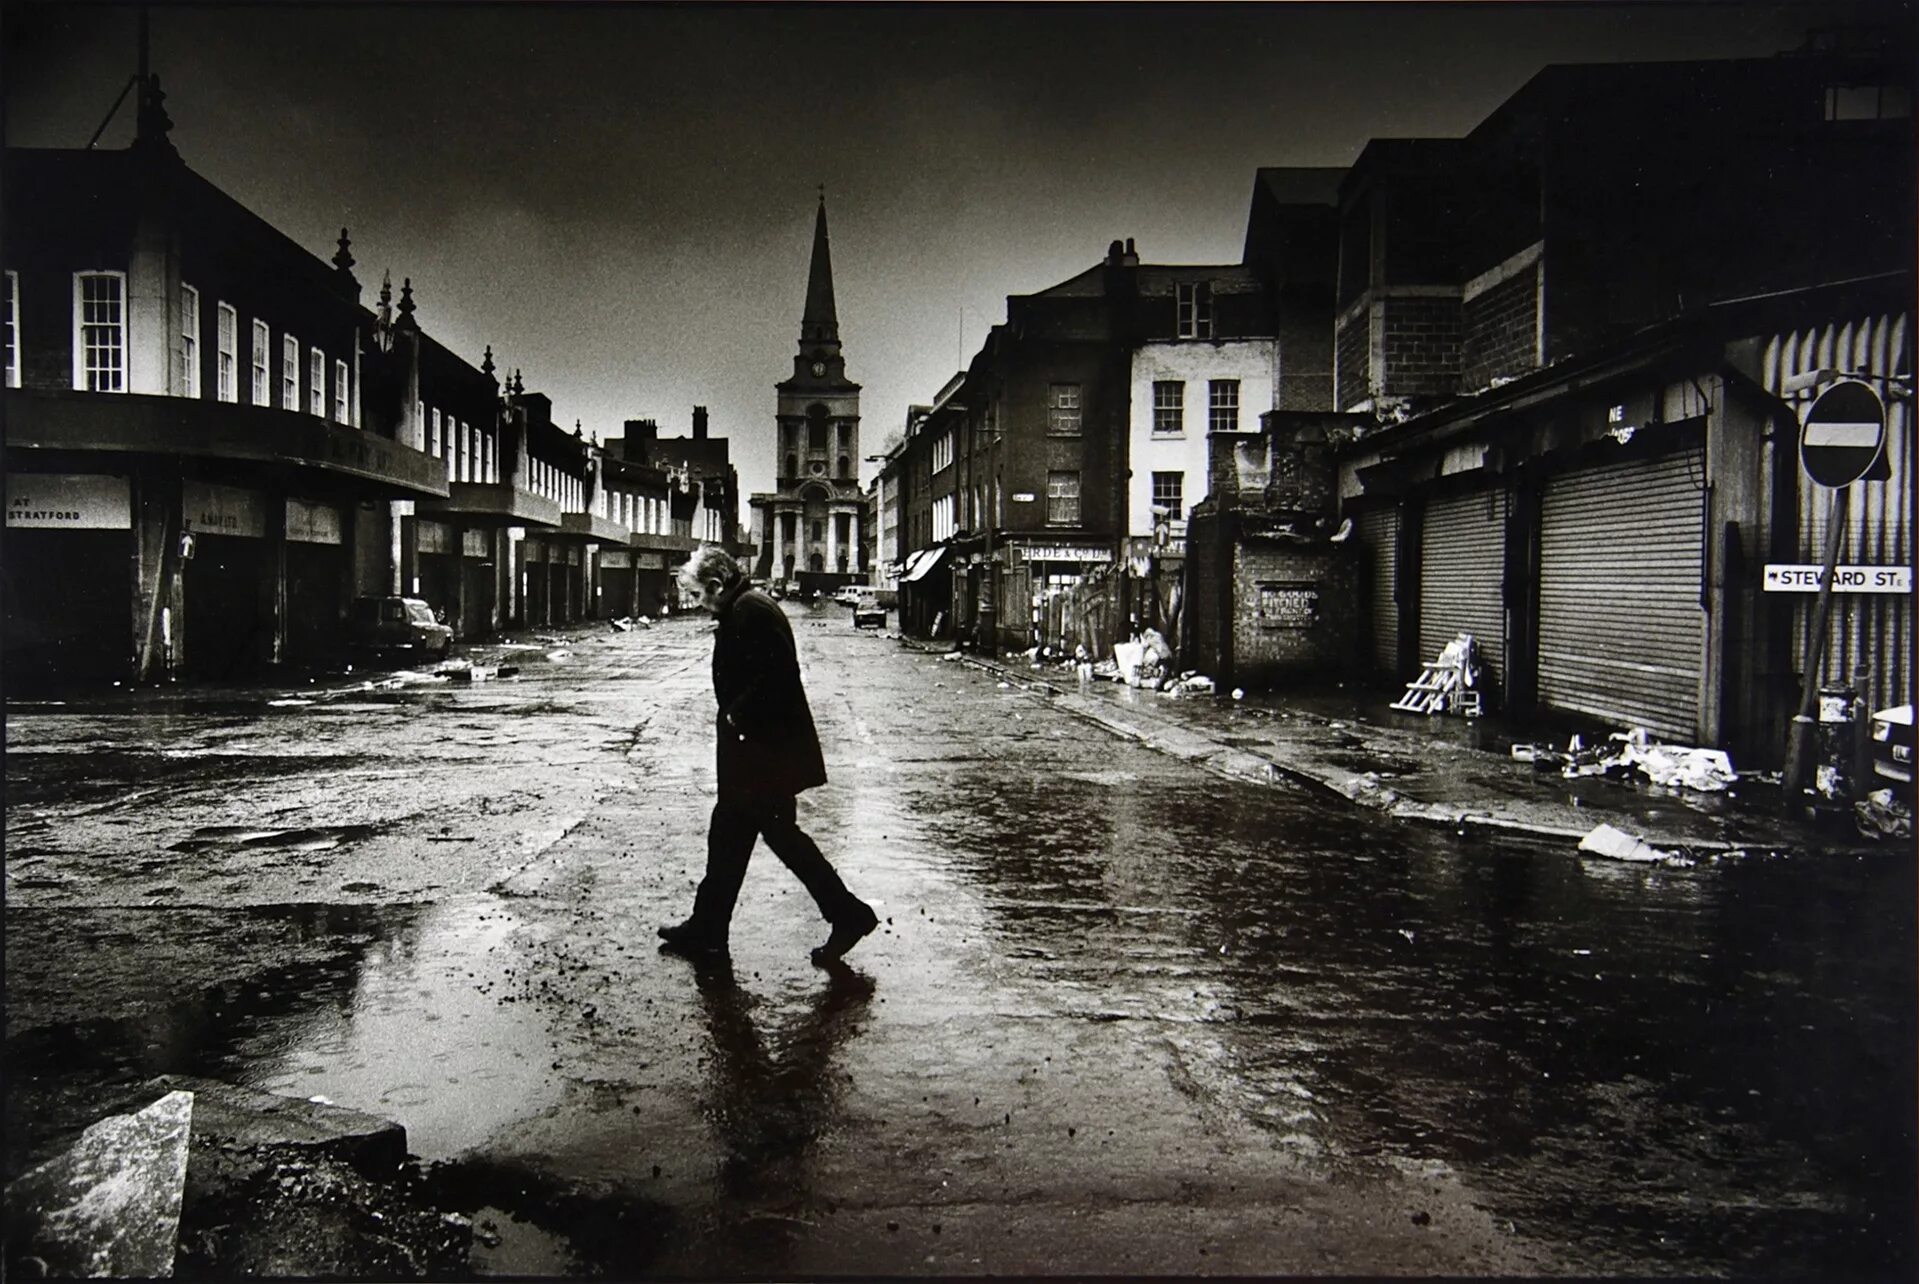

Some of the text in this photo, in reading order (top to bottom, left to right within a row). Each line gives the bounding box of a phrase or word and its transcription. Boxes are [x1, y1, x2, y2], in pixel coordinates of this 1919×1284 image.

[14, 498, 30, 507] AT
[8, 511, 80, 520] STRATFORD
[1875, 571, 1897, 586] ST
[1278, 590, 1318, 600] GOODS
